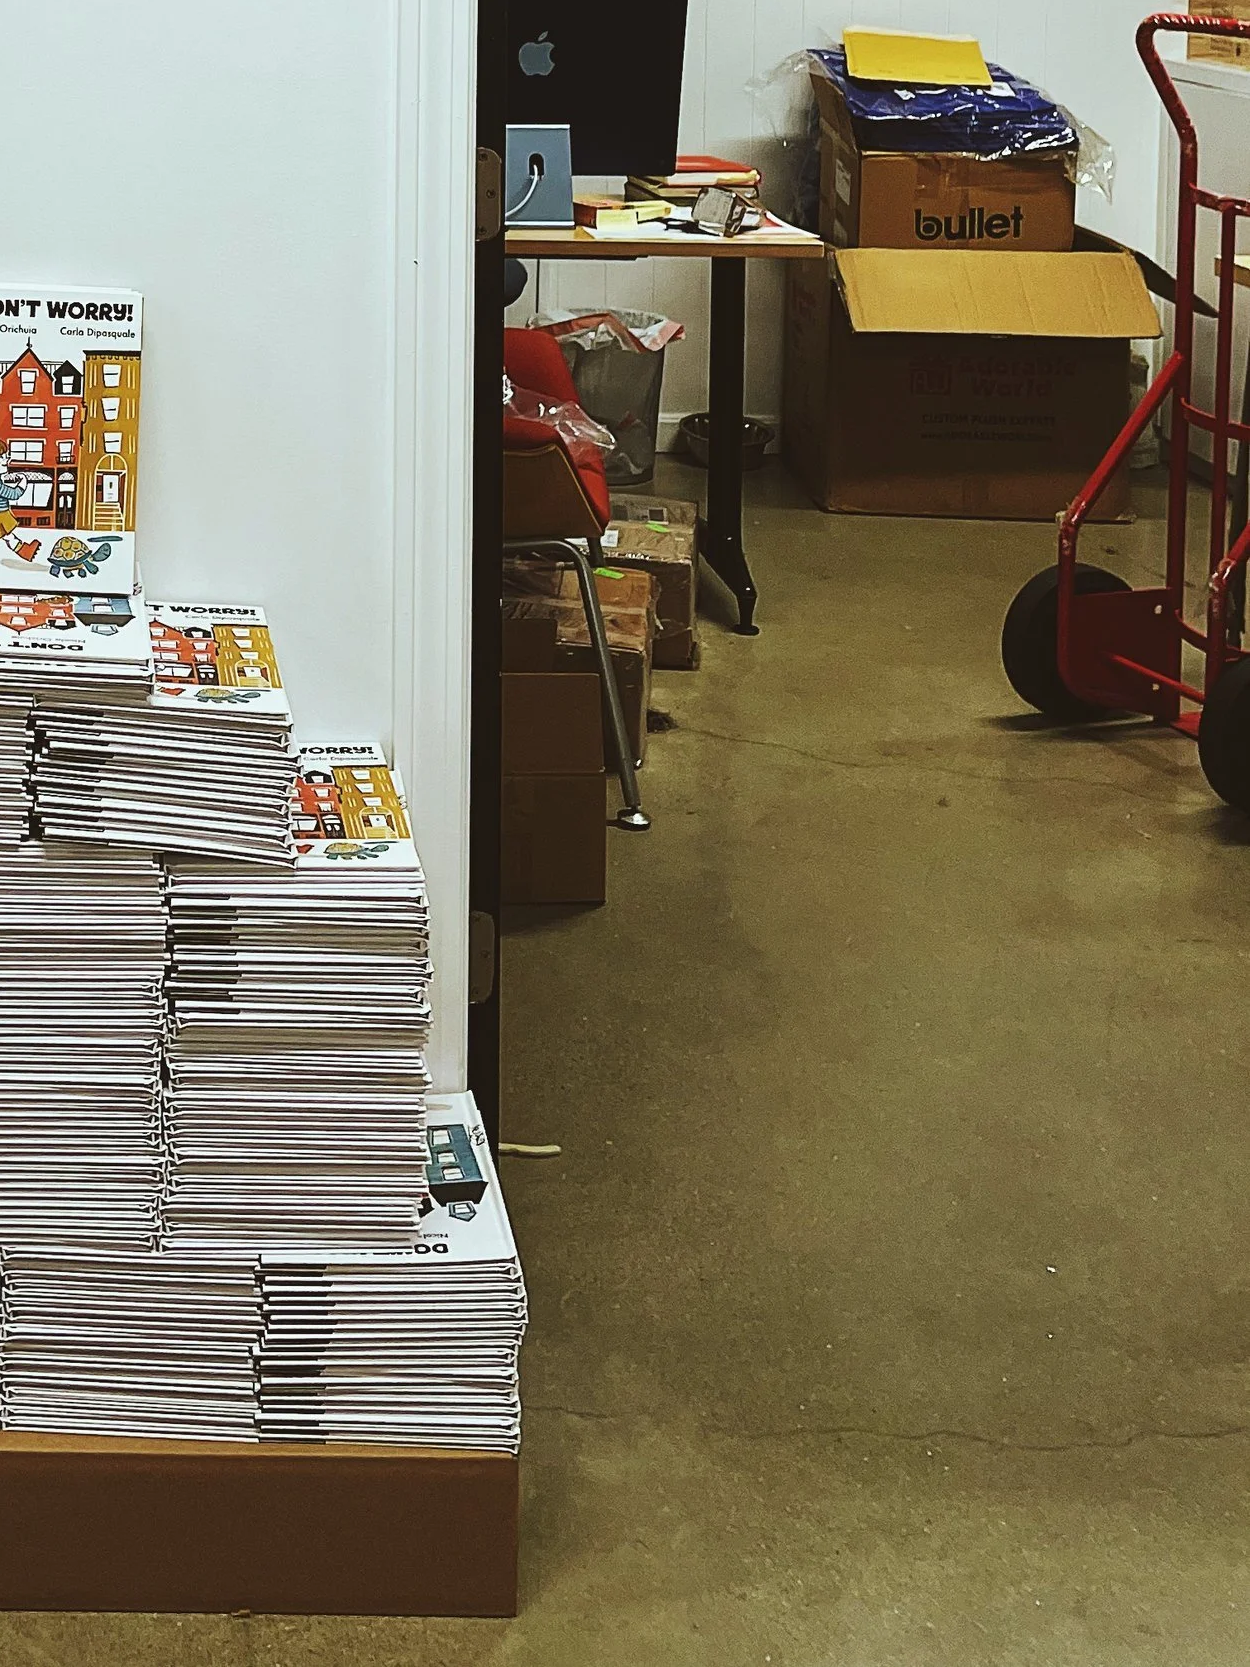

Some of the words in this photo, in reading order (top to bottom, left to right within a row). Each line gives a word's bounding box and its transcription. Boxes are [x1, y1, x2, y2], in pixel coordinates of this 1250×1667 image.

[913, 205, 1024, 241] bullet
[46, 301, 134, 322] WORRY!
[0, 324, 37, 335] Orichuia
[60, 327, 84, 337] Carla
[87, 328, 136, 340] Dipasquale
[169, 604, 257, 616] WORRY!
[8, 640, 84, 652] DON'T
